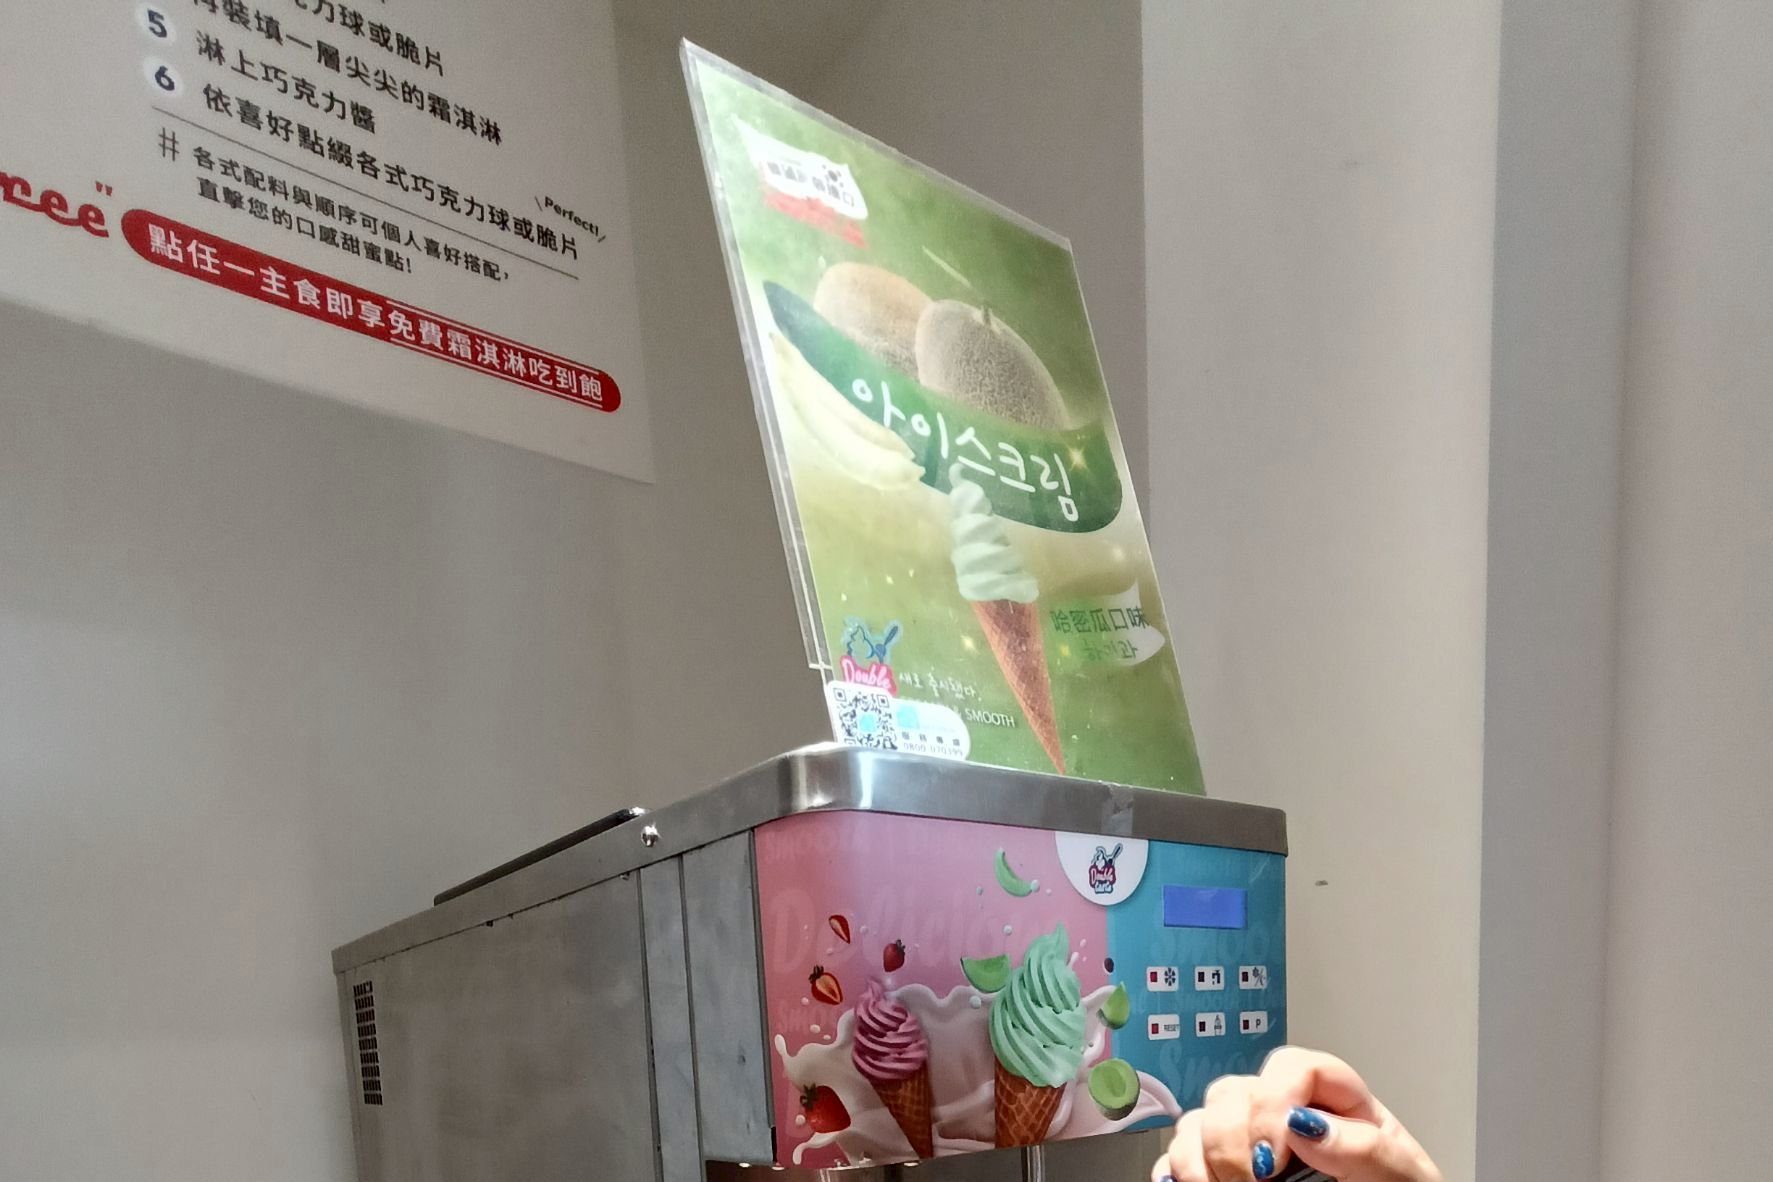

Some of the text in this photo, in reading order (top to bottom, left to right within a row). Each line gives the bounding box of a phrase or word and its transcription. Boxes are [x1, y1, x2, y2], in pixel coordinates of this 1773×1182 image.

[294, 0, 445, 77] 力球或脆片
[147, 10, 377, 134] 5 淋上巧克力醬
[154, 64, 579, 261] 6 依喜好點綴各式巧克力球或脆片
[543, 195, 600, 239] Perfect!
[148, 223, 604, 403] 點任一主食即享免費霜淇淋吃到飽
[852, 377, 1080, 523] 아이스크림
[1049, 606, 1151, 635] 哈密瓜口味
[841, 658, 893, 690] Double
[965, 708, 1016, 729] SMOOTH
[1163, 1023, 1181, 1032] RESET
[1255, 1018, 1262, 1029] P
